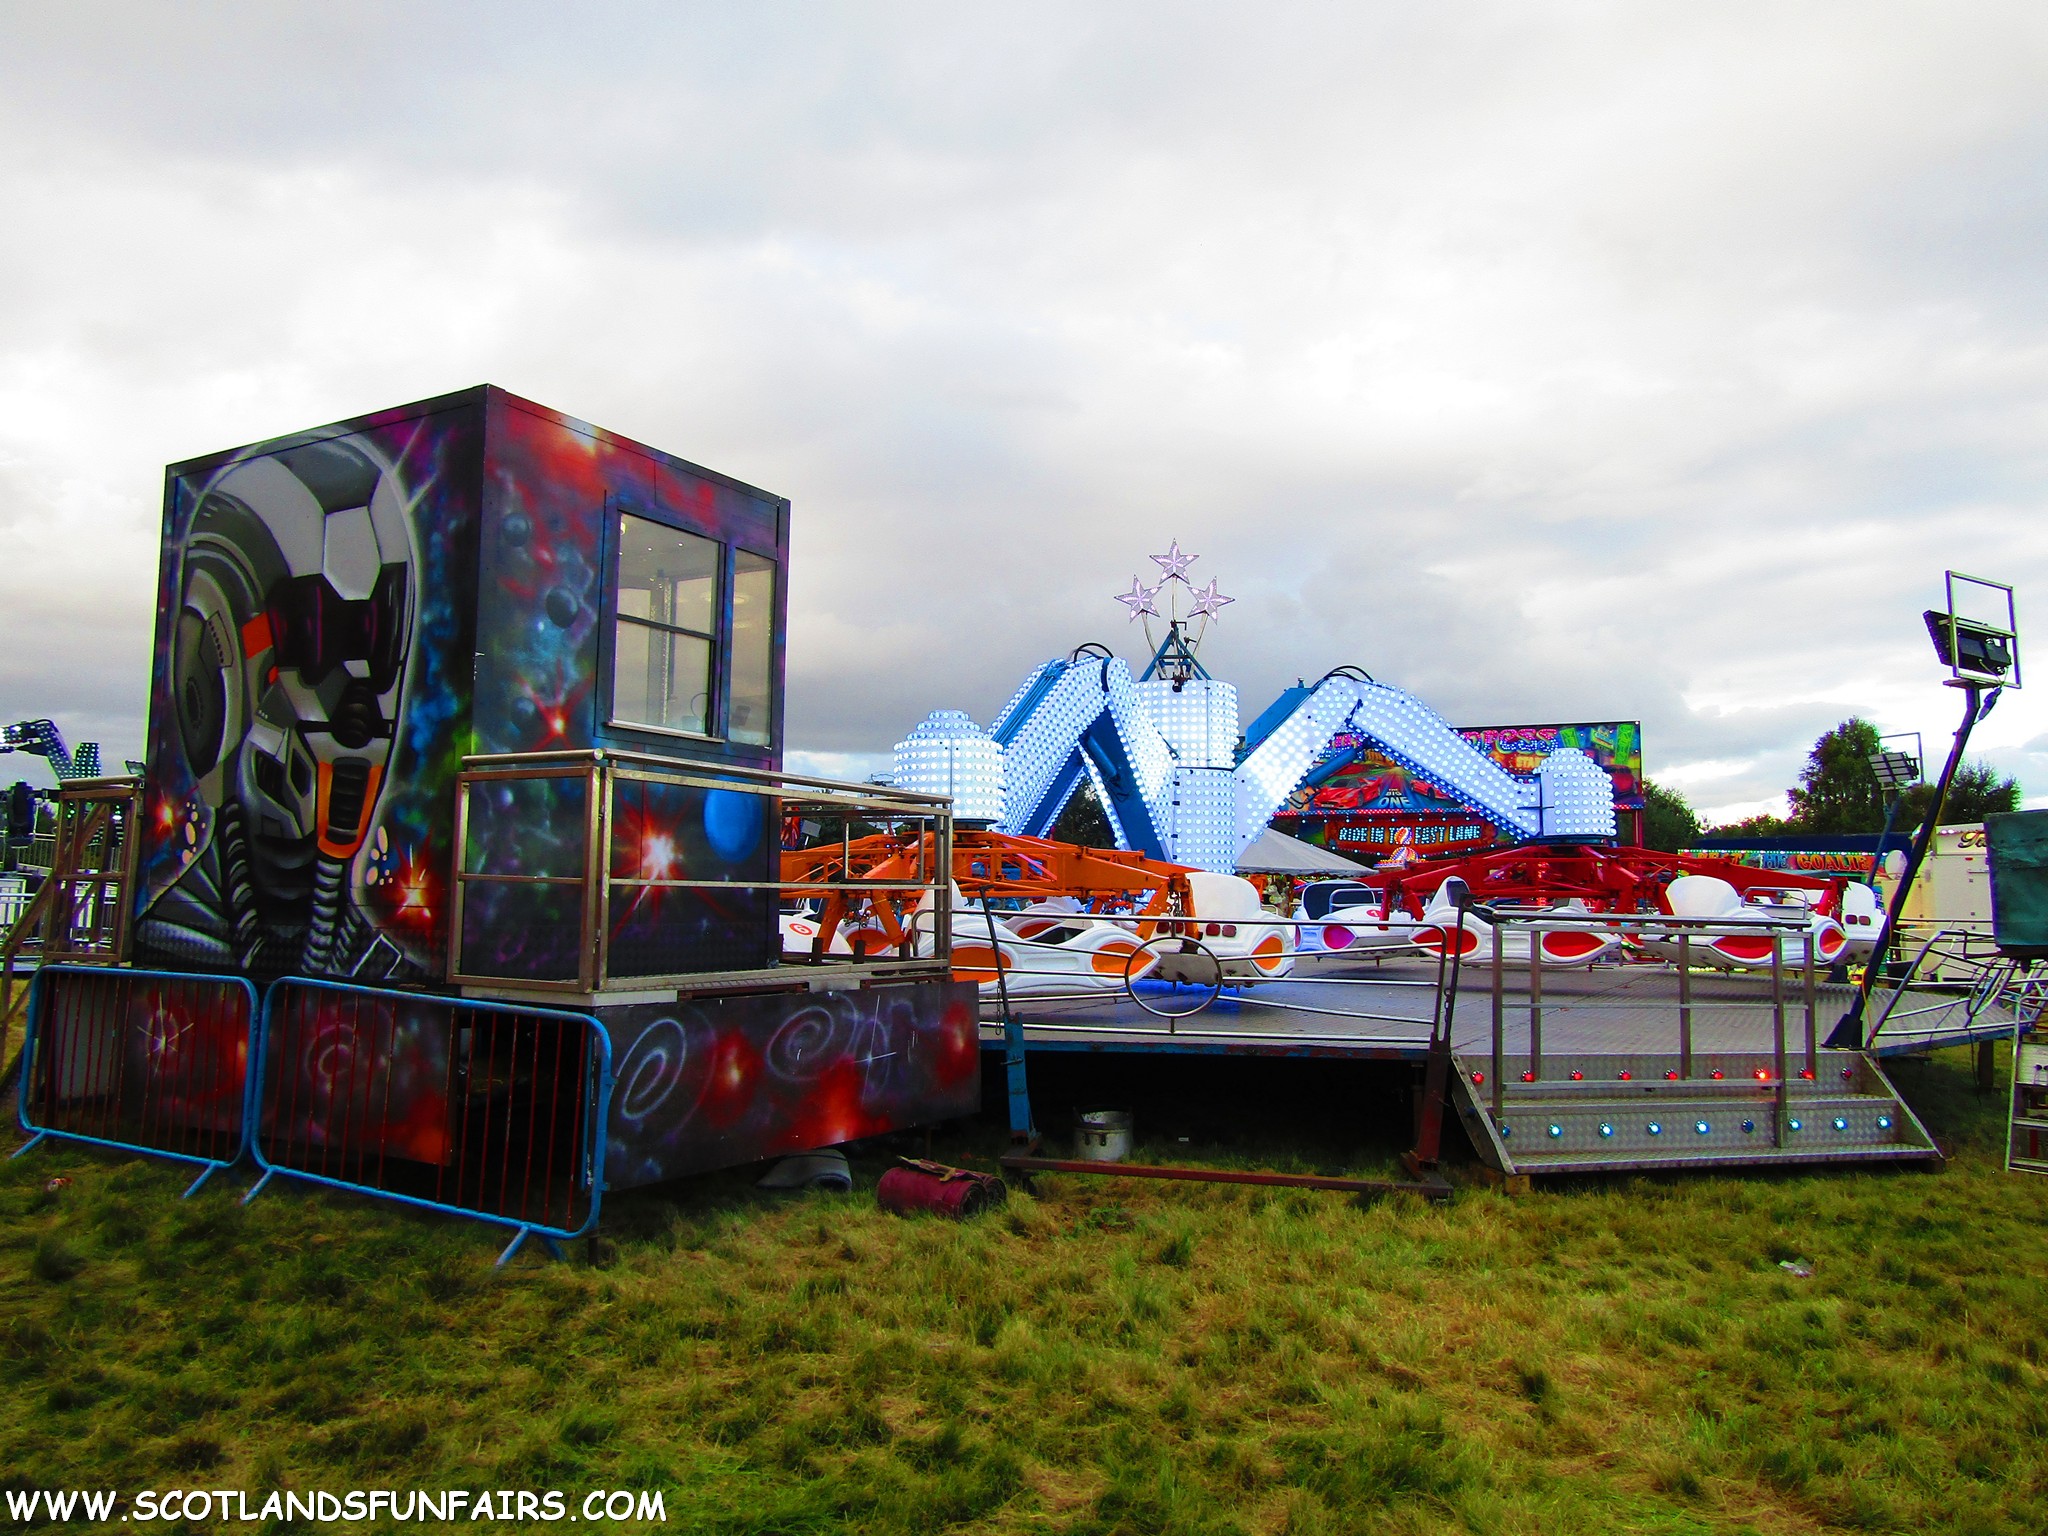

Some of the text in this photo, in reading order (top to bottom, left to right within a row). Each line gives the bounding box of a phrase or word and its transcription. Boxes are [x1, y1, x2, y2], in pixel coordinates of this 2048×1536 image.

[1377, 796, 1413, 808] ONE
[1339, 827, 1368, 841] RIDE
[1370, 827, 1385, 843] IN
[1414, 826, 1445, 844] FAST
[1449, 825, 1481, 841] LANE
[1797, 854, 1869, 871] GOALIE
